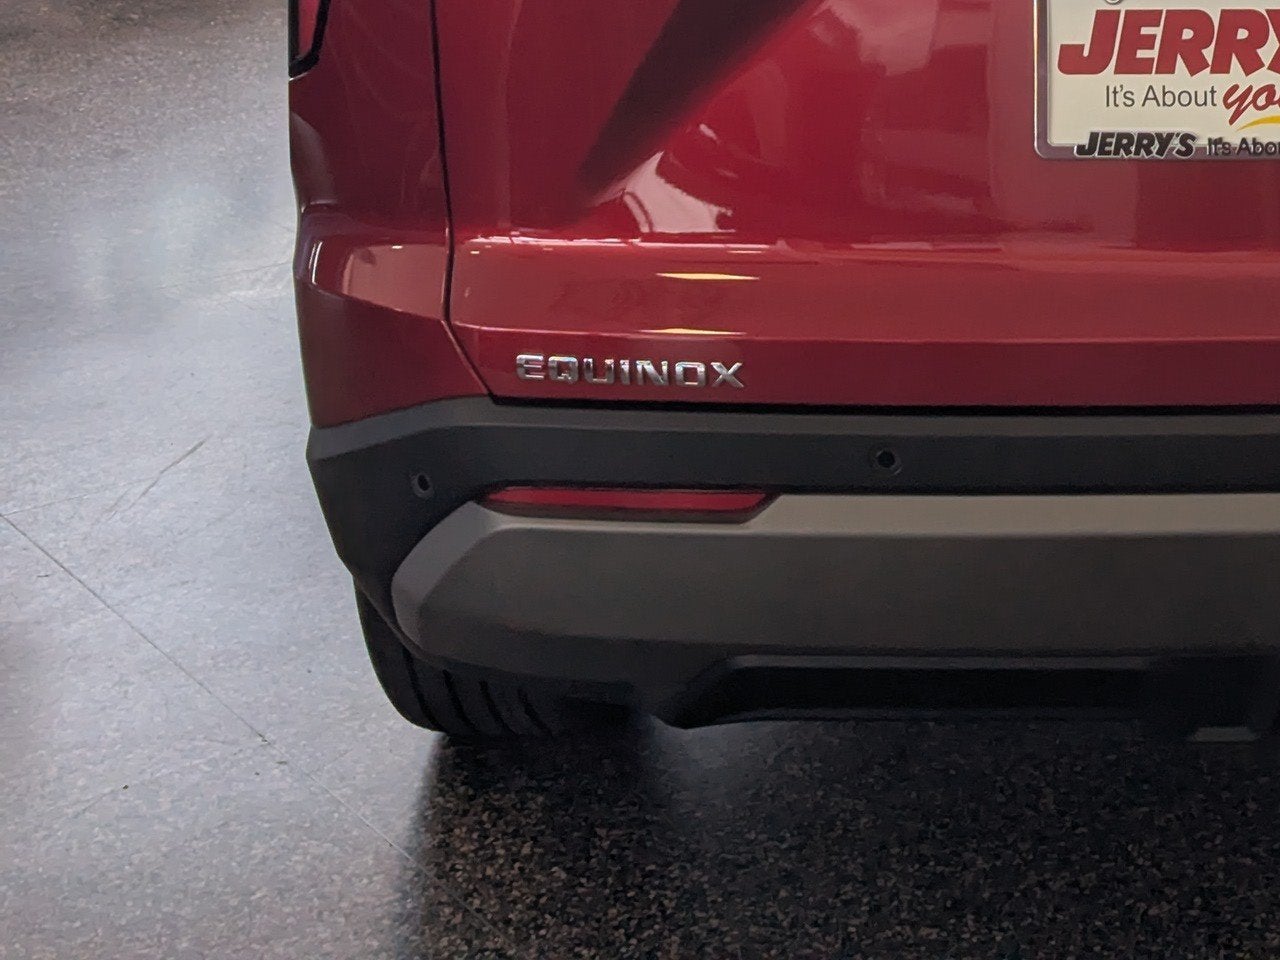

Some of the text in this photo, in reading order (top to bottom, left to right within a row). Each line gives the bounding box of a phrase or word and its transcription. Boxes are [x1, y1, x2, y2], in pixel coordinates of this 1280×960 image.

[1105, 84, 1136, 108] It's
[1141, 84, 1218, 108] About
[1074, 130, 1198, 158] JERRY'S
[1206, 136, 1233, 157] It's
[516, 353, 745, 389] EQUINOX
